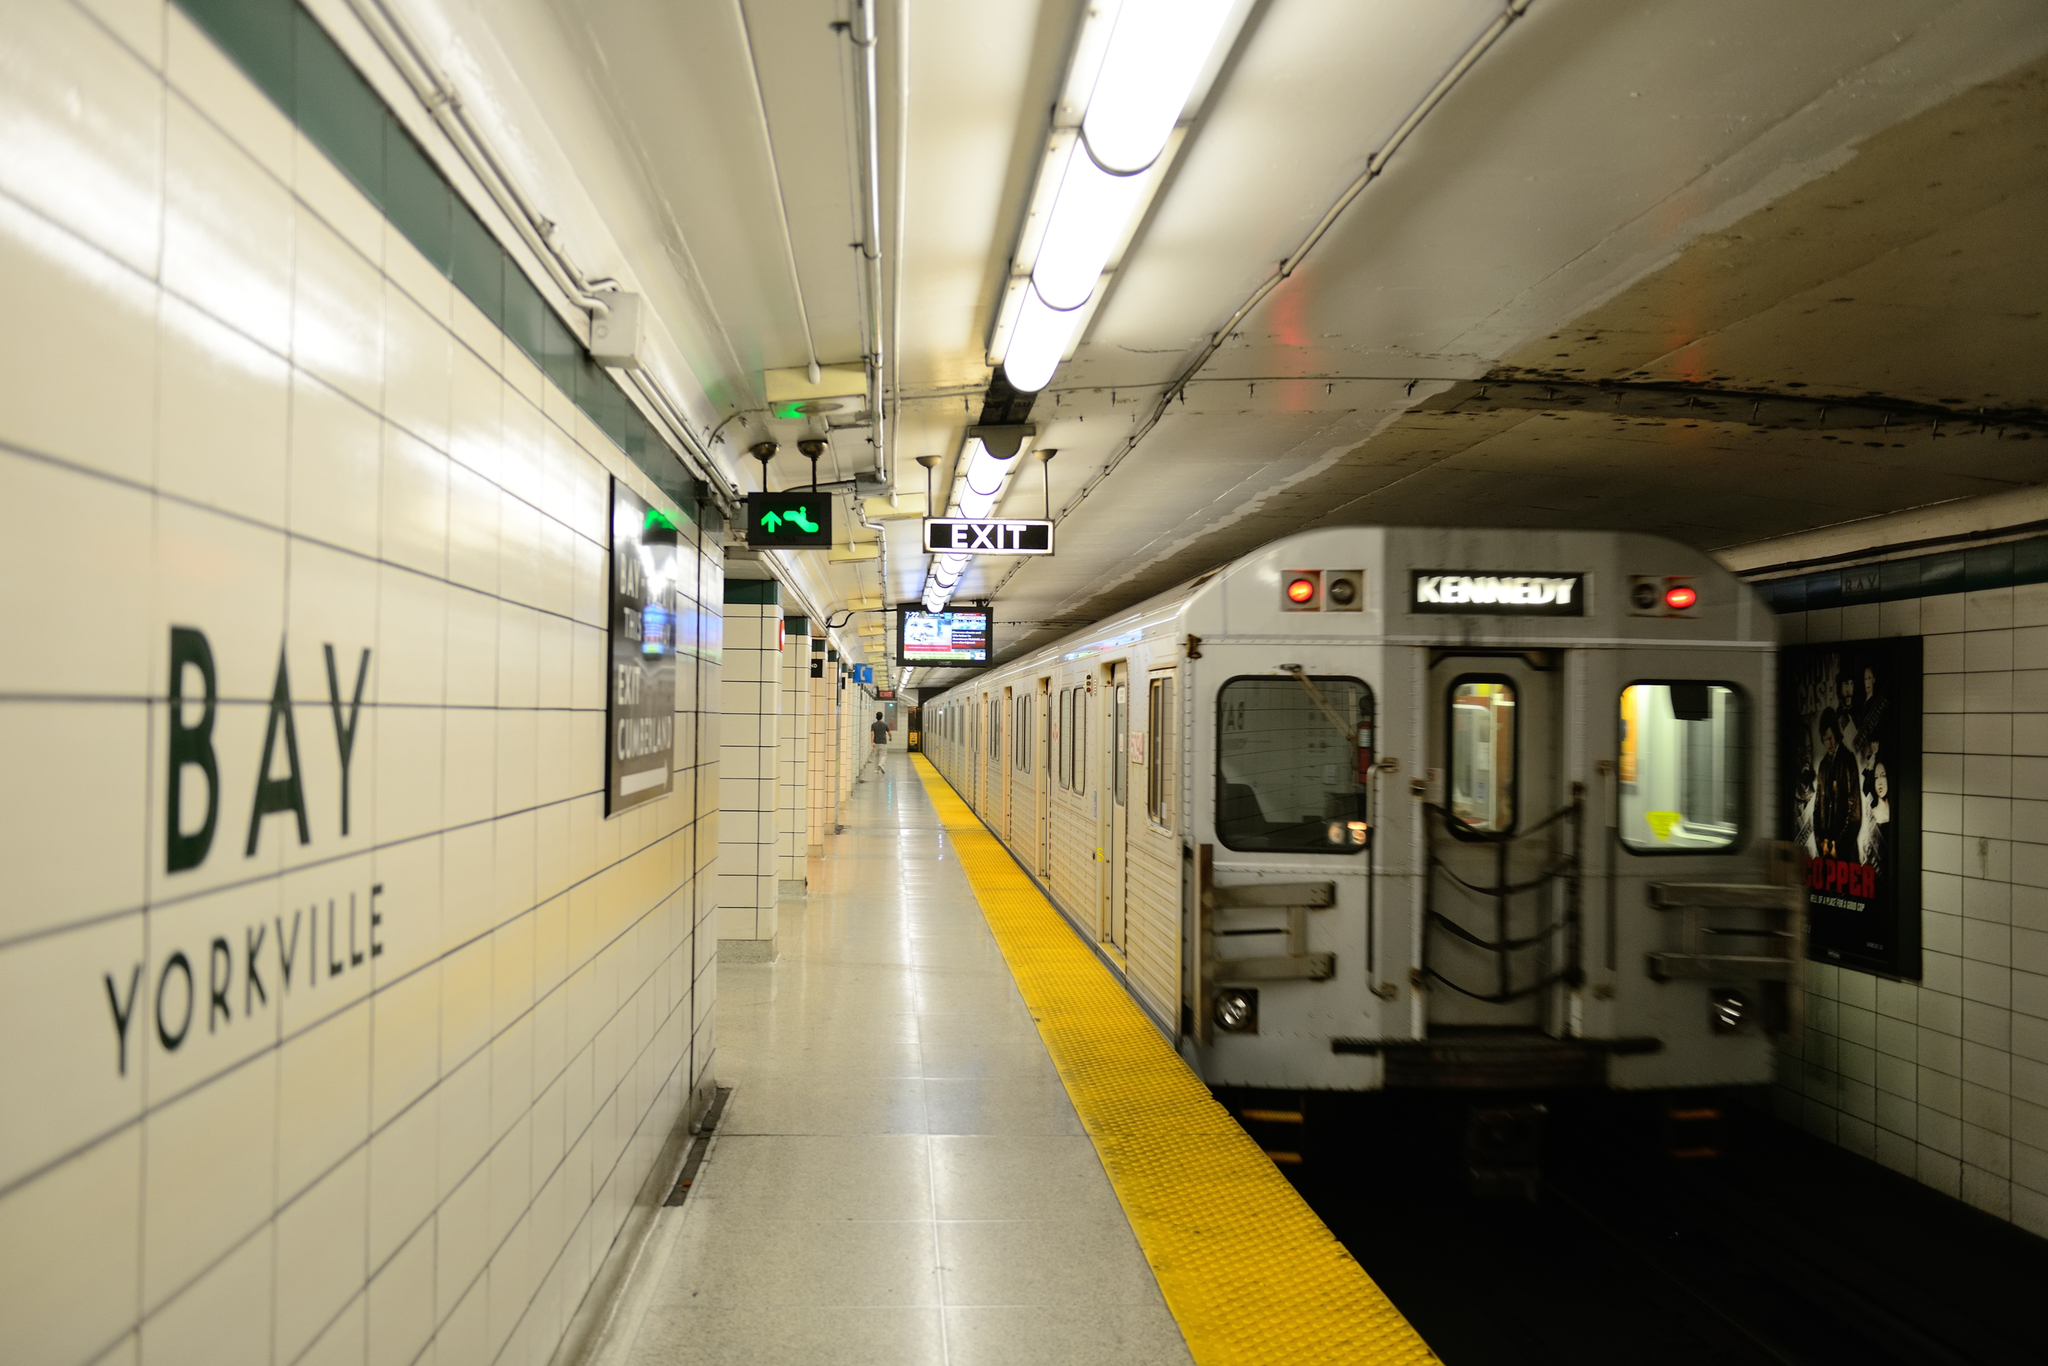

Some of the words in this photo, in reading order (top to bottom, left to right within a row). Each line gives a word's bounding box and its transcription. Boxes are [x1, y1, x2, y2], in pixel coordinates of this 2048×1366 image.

[951, 524, 1027, 549] EXIT
[1417, 575, 1578, 606] KENNEDY
[1845, 574, 1877, 593] BAY
[618, 664, 641, 706] EXIT
[1797, 681, 1838, 715] CASE
[166, 623, 371, 875] BAY
[617, 716, 672, 761] CUMBERLAND
[1802, 856, 1875, 899] COPPER
[102, 884, 384, 1077] YORKVILLE
